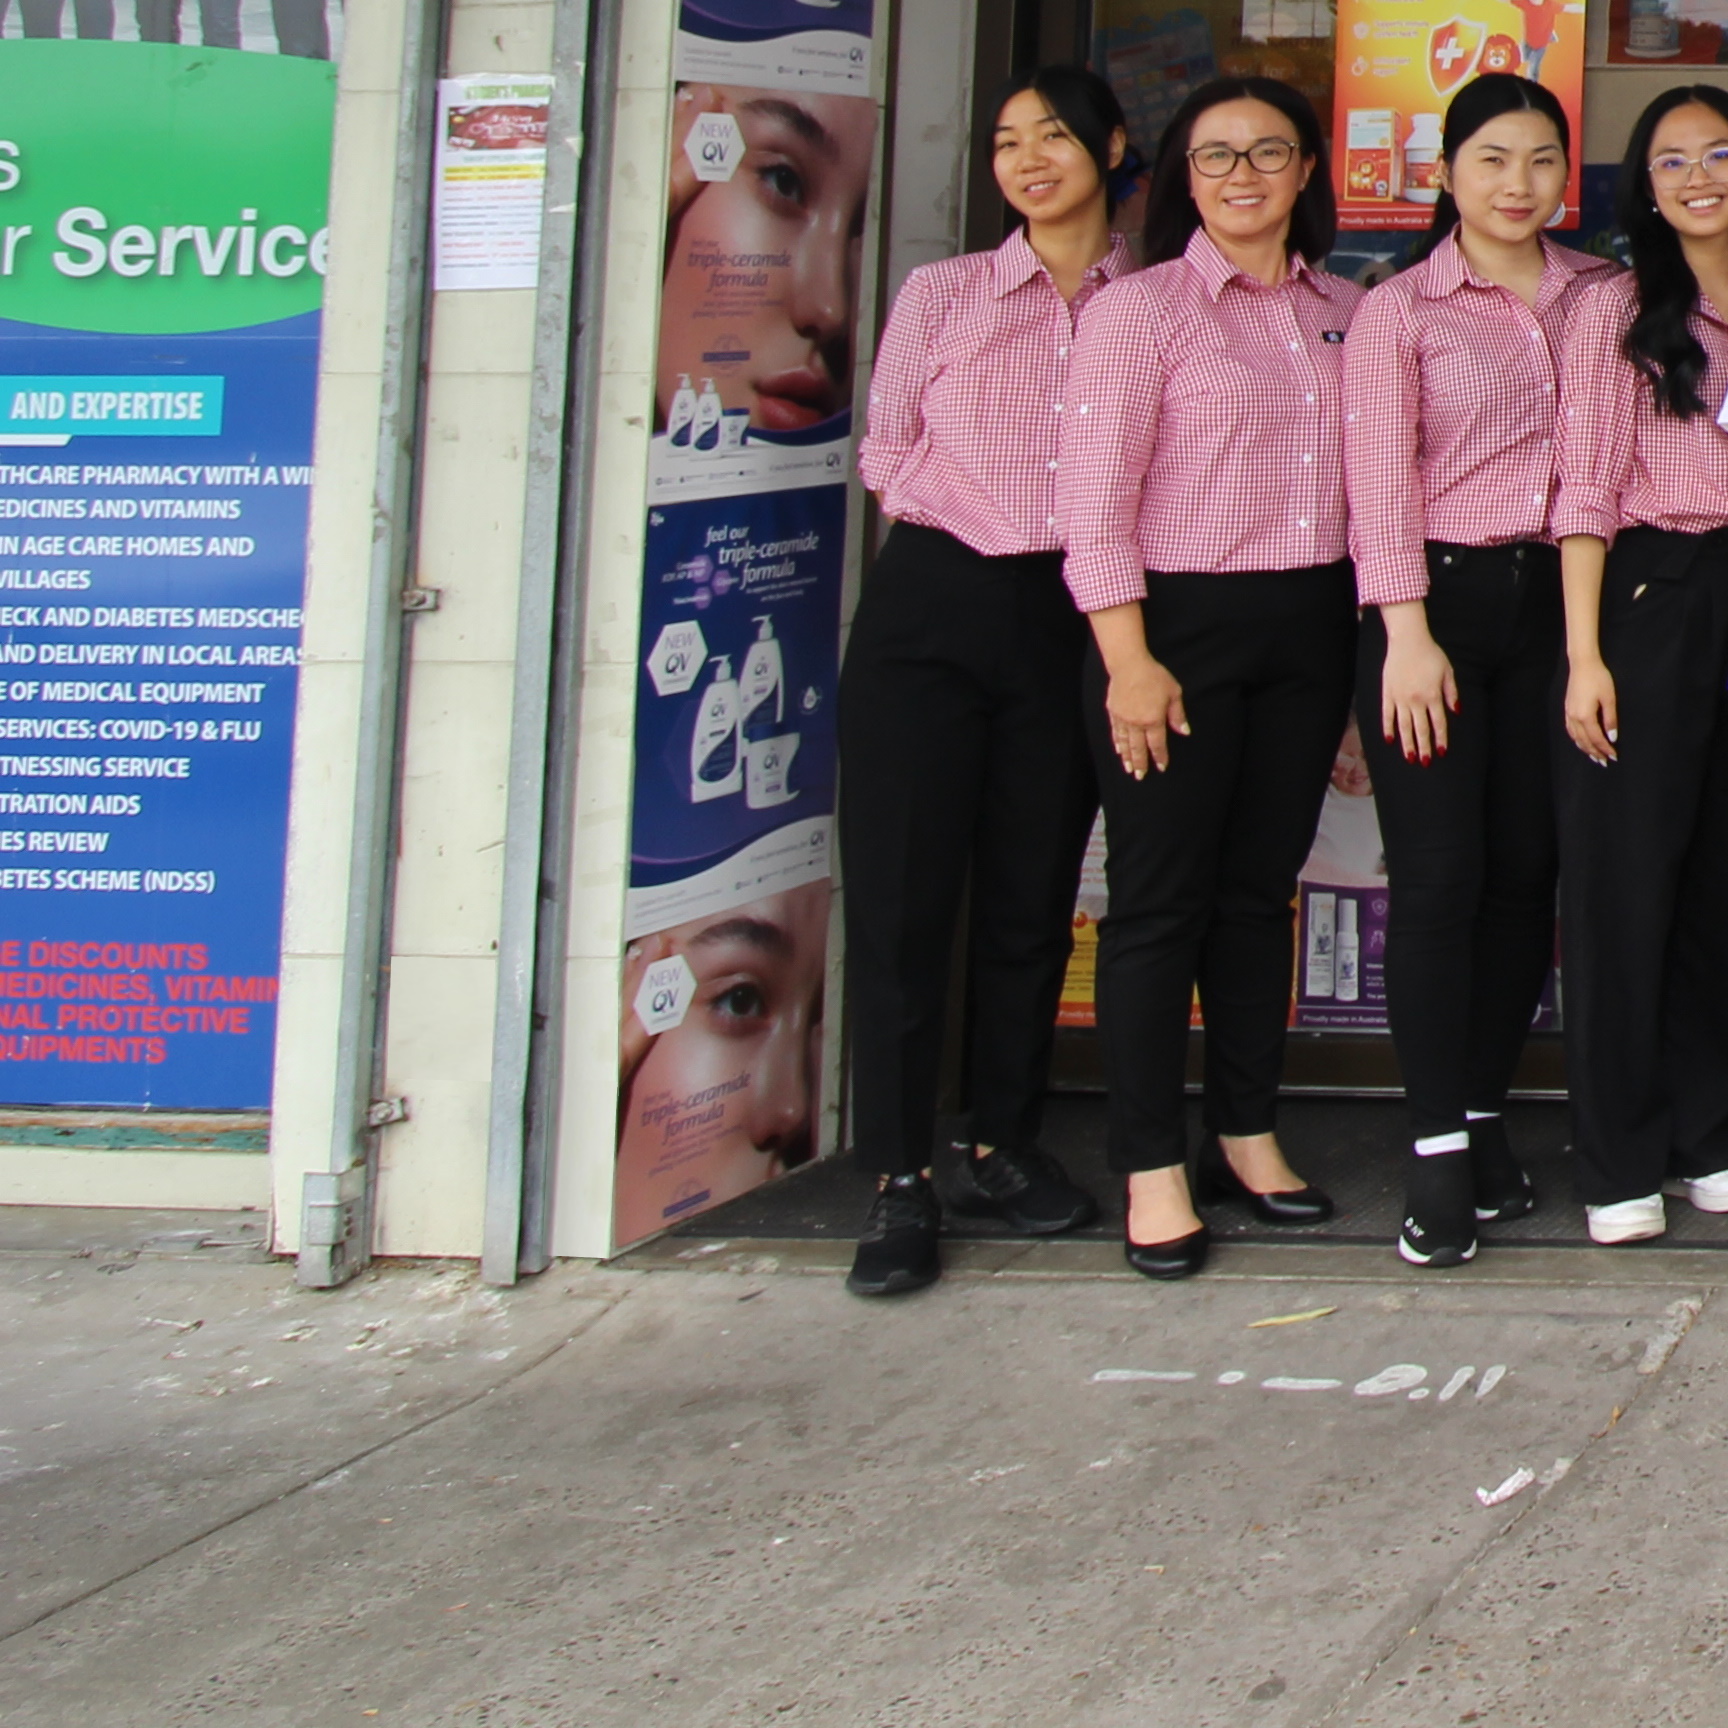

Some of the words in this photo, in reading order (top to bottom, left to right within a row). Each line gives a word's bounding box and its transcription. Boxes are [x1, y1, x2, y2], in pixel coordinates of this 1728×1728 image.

[701, 141, 731, 164] QV
[687, 251, 792, 275] triple-ceramide
[708, 268, 769, 290] formula
[10, 392, 65, 421] AND
[71, 392, 204, 421] EXPERTISE
[83, 465, 202, 486] PHARMACY
[205, 465, 260, 486] WITH
[263, 465, 280, 486] A
[90, 499, 138, 520] AND
[140, 499, 242, 520] VITAMINS
[23, 536, 65, 557] AGE
[68, 536, 123, 557] CARE
[127, 536, 202, 557] HOMES
[207, 536, 255, 557] AND
[718, 531, 820, 566] triple-ceramide
[739, 559, 796, 590] formula
[43, 607, 91, 629] AND
[93, 607, 195, 629] DIABETES
[38, 643, 139, 666] DELIVERY
[142, 643, 165, 666] IN
[169, 643, 237, 666] LOCAL
[665, 653, 690, 674] QV
[11, 681, 39, 704] OF
[42, 681, 138, 704] MEDICAL
[140, 681, 266, 704] EQUIPMENT
[100, 718, 199, 741] COVID-19
[201, 718, 218, 741] &
[221, 718, 262, 741] FLU
[104, 755, 191, 778] SERVICE
[90, 793, 141, 816] AIDS
[28, 831, 110, 853] REVIEW
[55, 868, 141, 893] SCHEME
[144, 868, 216, 893] (NDSS)
[28, 940, 209, 970] DISCOUNTS
[651, 989, 680, 1013] QV
[59, 1003, 251, 1034] PROTECTIVE
[641, 1070, 752, 1128] triple-ceramide
[662, 1102, 726, 1146] formula
